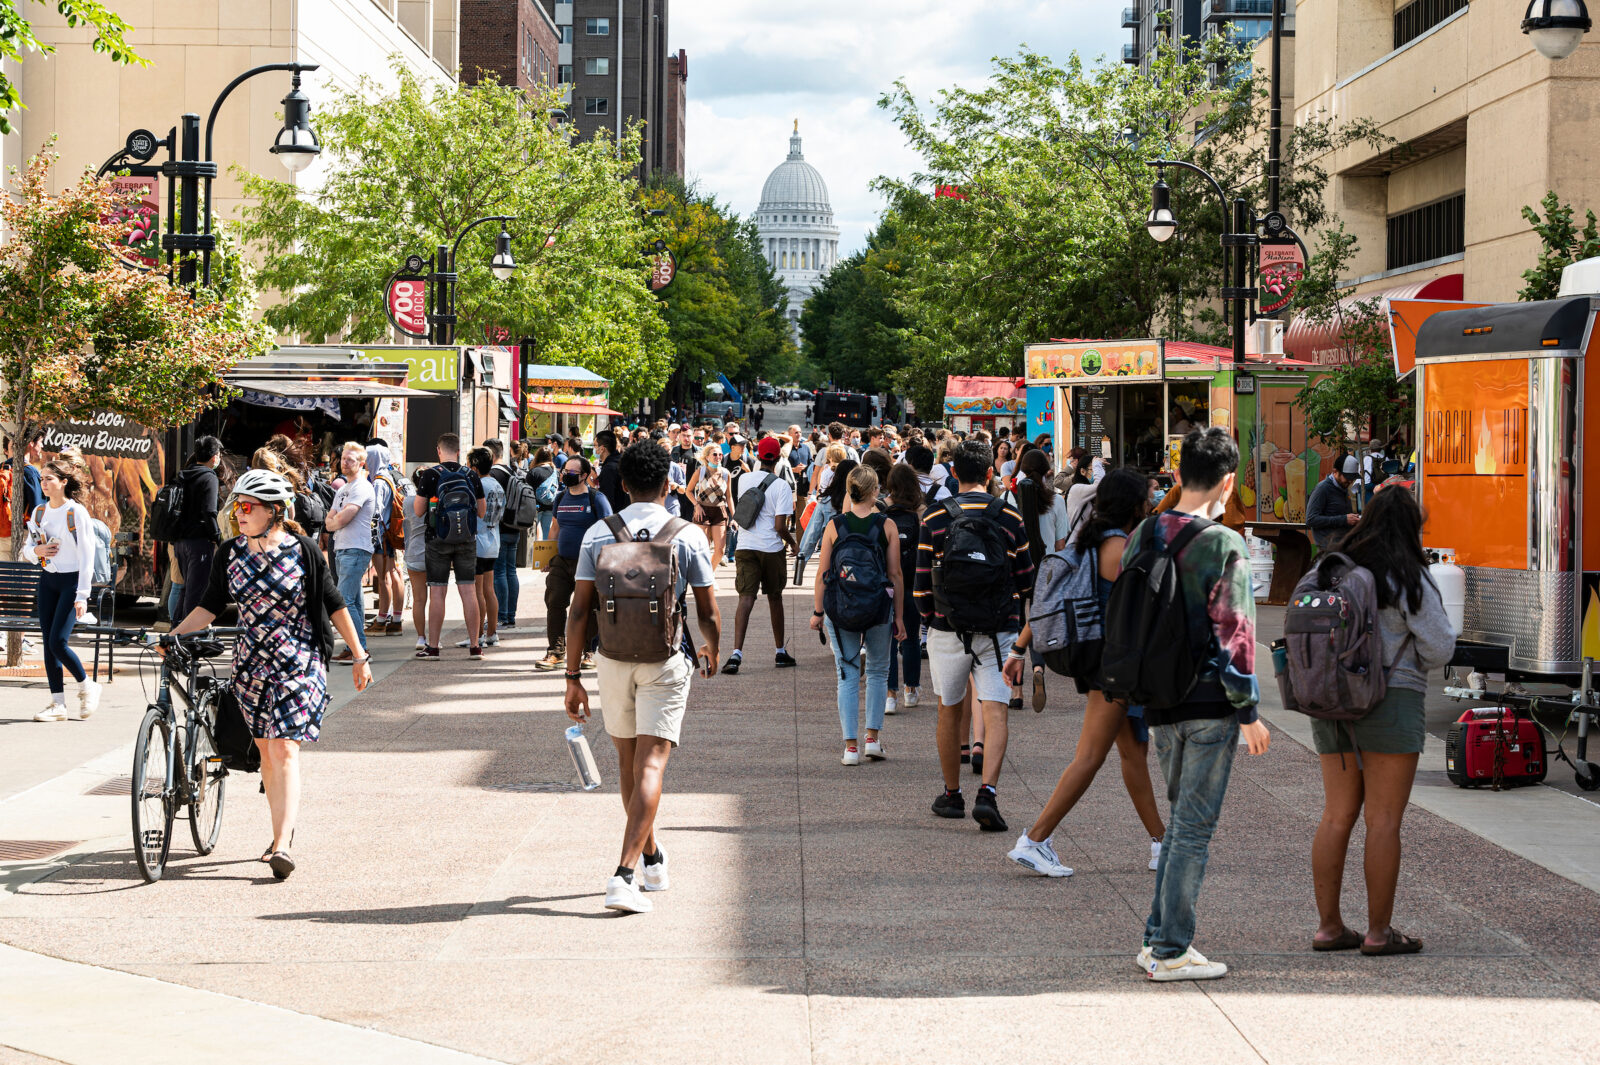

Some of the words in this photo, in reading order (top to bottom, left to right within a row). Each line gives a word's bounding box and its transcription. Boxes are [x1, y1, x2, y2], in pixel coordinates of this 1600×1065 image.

[1263, 253, 1295, 261] Madison
[394, 282, 414, 324] 700
[413, 290, 425, 325] BLOCK
[44, 427, 95, 448] KOREAN
[94, 430, 151, 453] BURRITO
[1424, 409, 1472, 465] HIBACHI
[1503, 407, 1529, 465] HUT
